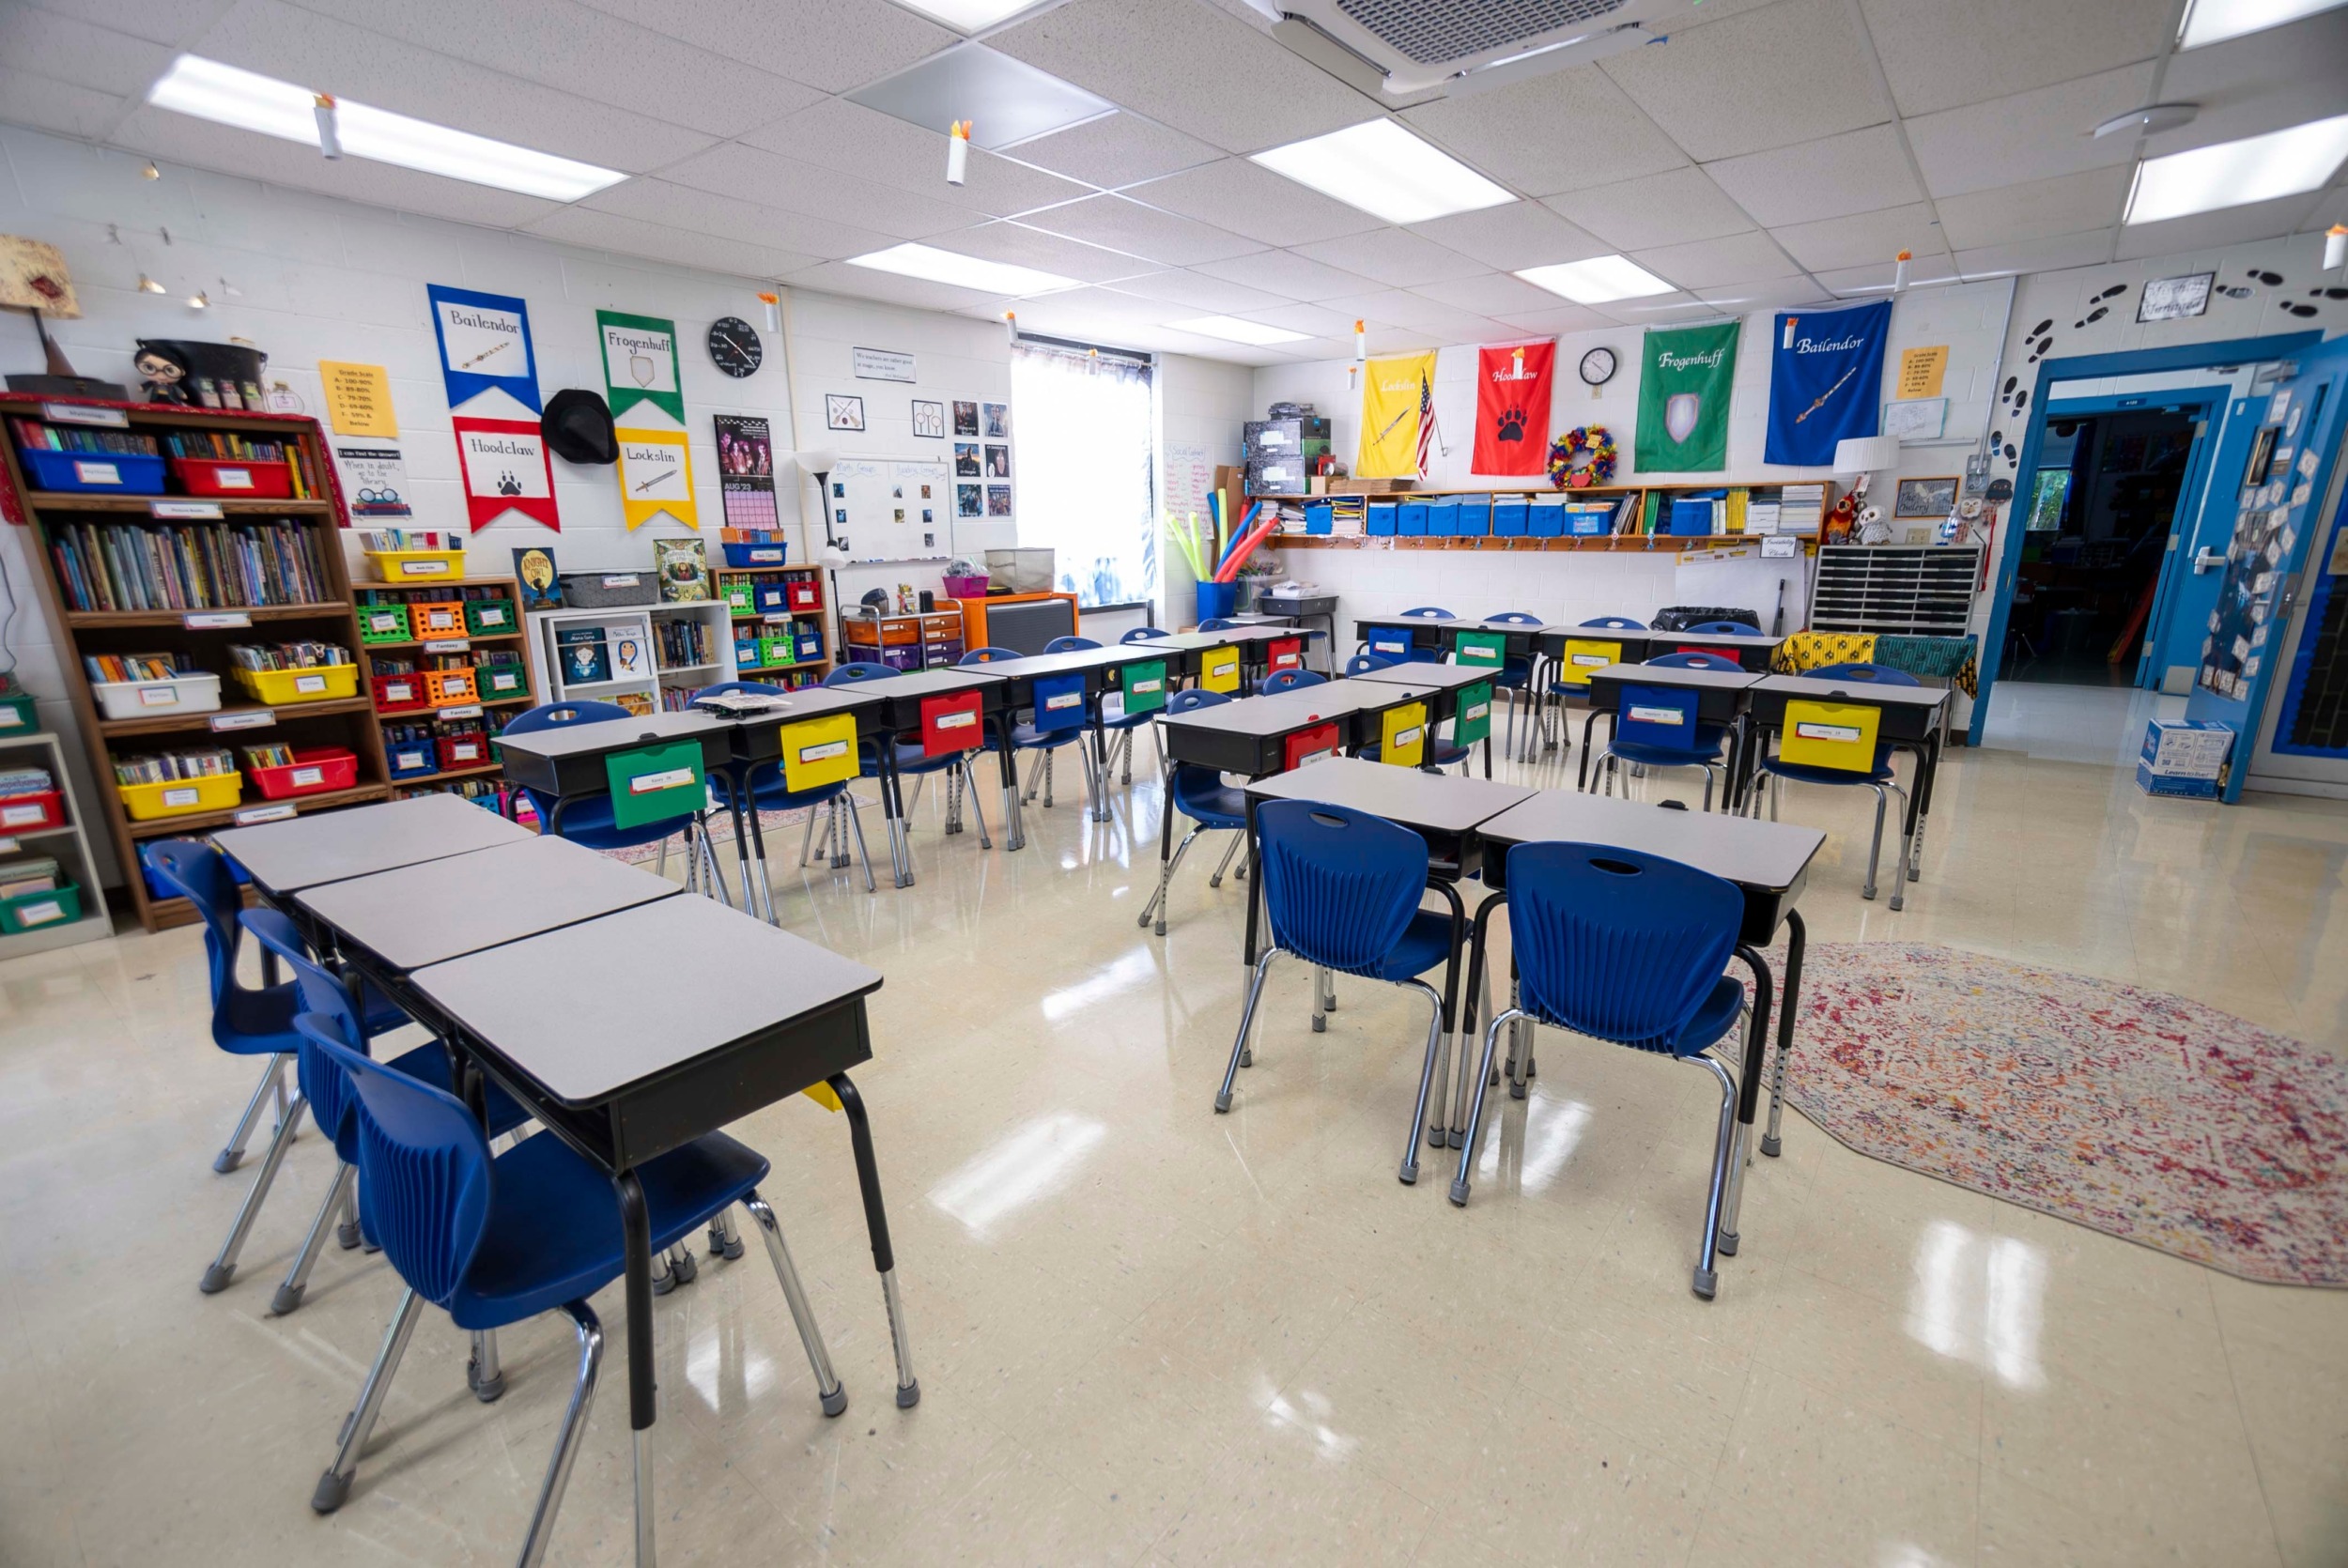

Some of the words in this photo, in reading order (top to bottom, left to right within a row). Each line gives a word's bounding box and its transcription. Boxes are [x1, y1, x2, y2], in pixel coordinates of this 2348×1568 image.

[451, 310, 519, 333] Bailendor
[609, 331, 670, 355] Frogenhuff
[1797, 334, 1863, 355] Bailendor
[1659, 348, 1725, 372] Frogenhuff
[1492, 367, 1537, 382] Hoolaw
[1382, 379, 1415, 392] Lockslin
[471, 438, 535, 456] Hoodclaw
[626, 448, 675, 463] Lockslin
[344, 460, 364, 470] When
[378, 461, 400, 471] doubt,
[836, 462, 853, 472] Math
[857, 463, 875, 473] Groups
[1901, 492, 1916, 502] The
[1899, 502, 1930, 515] Owlery
[1764, 537, 1796, 548] Invisibility
[523, 557, 548, 571] KNIGHT
[530, 568, 546, 578] OWL
